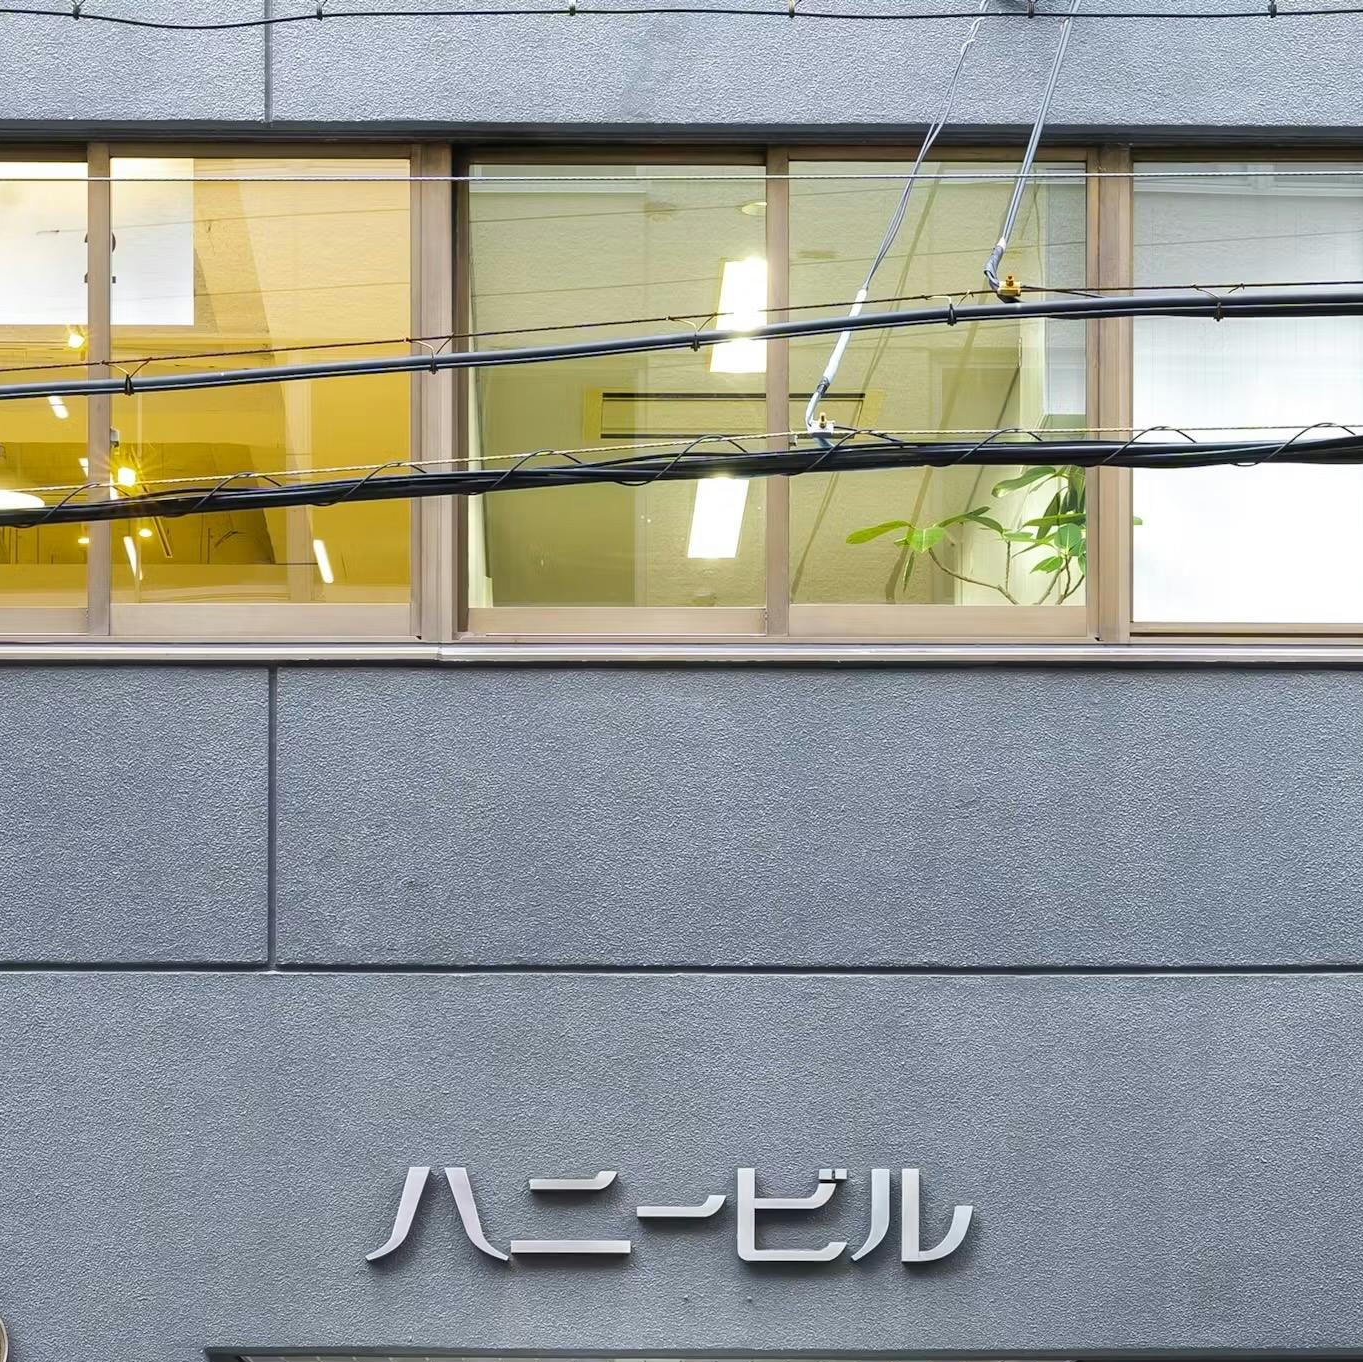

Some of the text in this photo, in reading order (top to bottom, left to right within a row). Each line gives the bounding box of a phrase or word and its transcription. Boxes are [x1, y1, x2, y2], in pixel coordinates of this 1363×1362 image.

[364, 1165, 975, 1264] ハニービル
